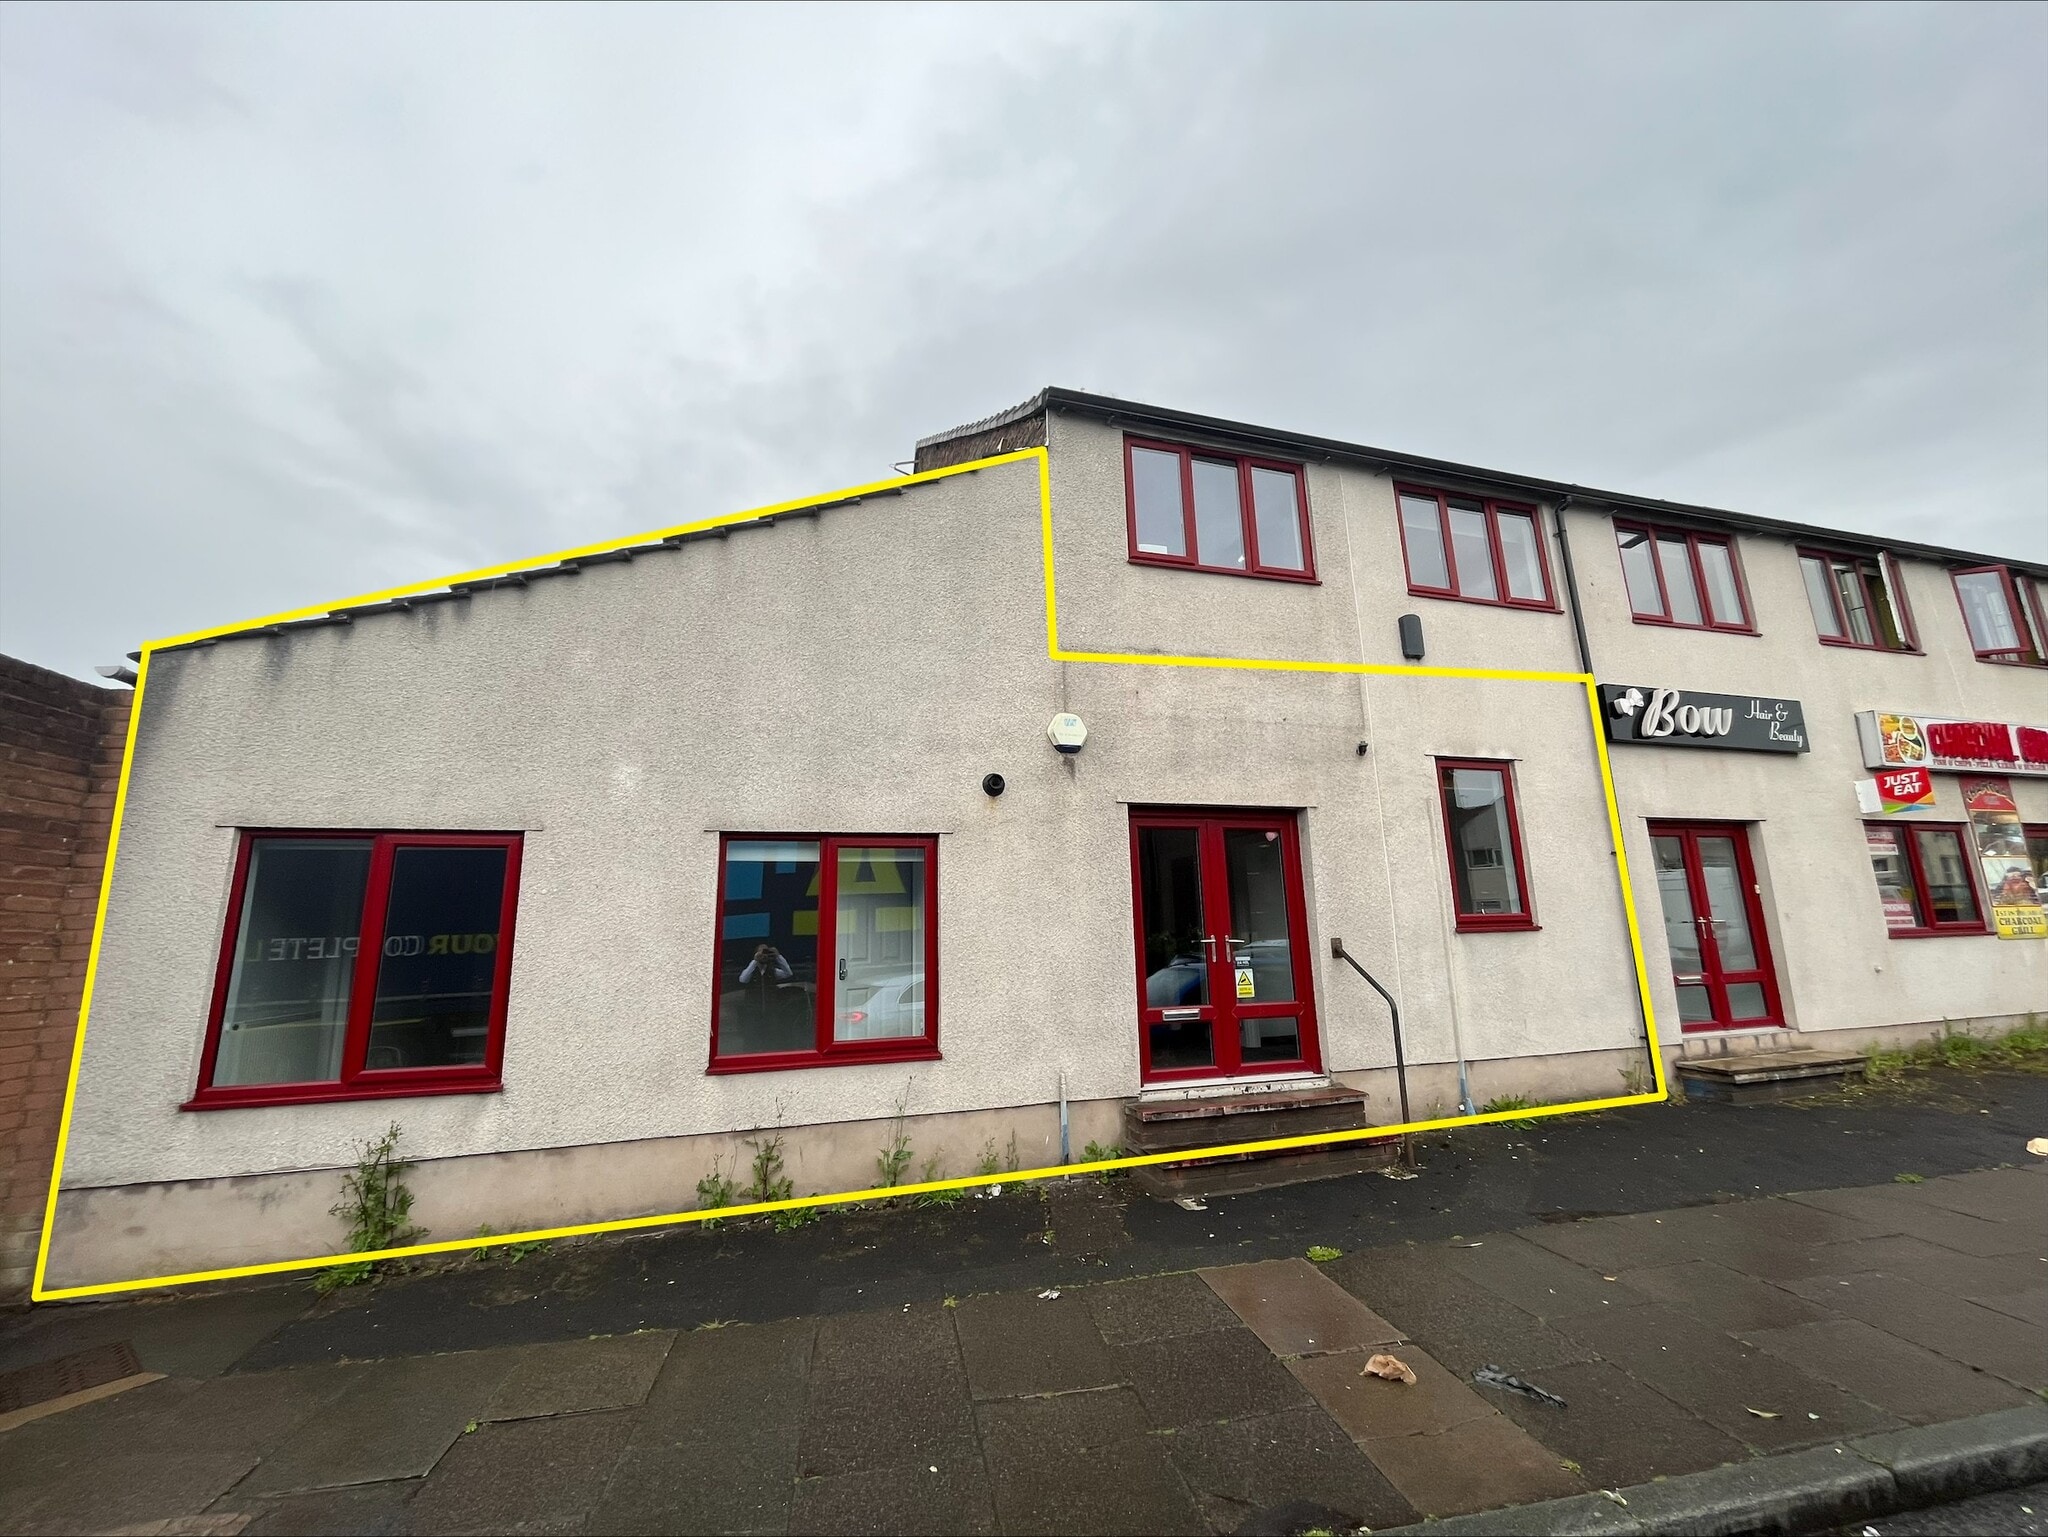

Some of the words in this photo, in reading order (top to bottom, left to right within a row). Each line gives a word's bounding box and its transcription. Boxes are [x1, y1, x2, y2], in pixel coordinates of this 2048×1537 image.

[1641, 687, 1733, 738] Bow
[1744, 700, 1773, 719] Hair
[1775, 703, 1788, 722] &
[1769, 721, 1803, 748] Beauty
[1883, 771, 1920, 789] JUST
[1893, 782, 1922, 796] EAT
[1999, 917, 2044, 926] CHARCOAL
[2011, 926, 2035, 935] GRILL
